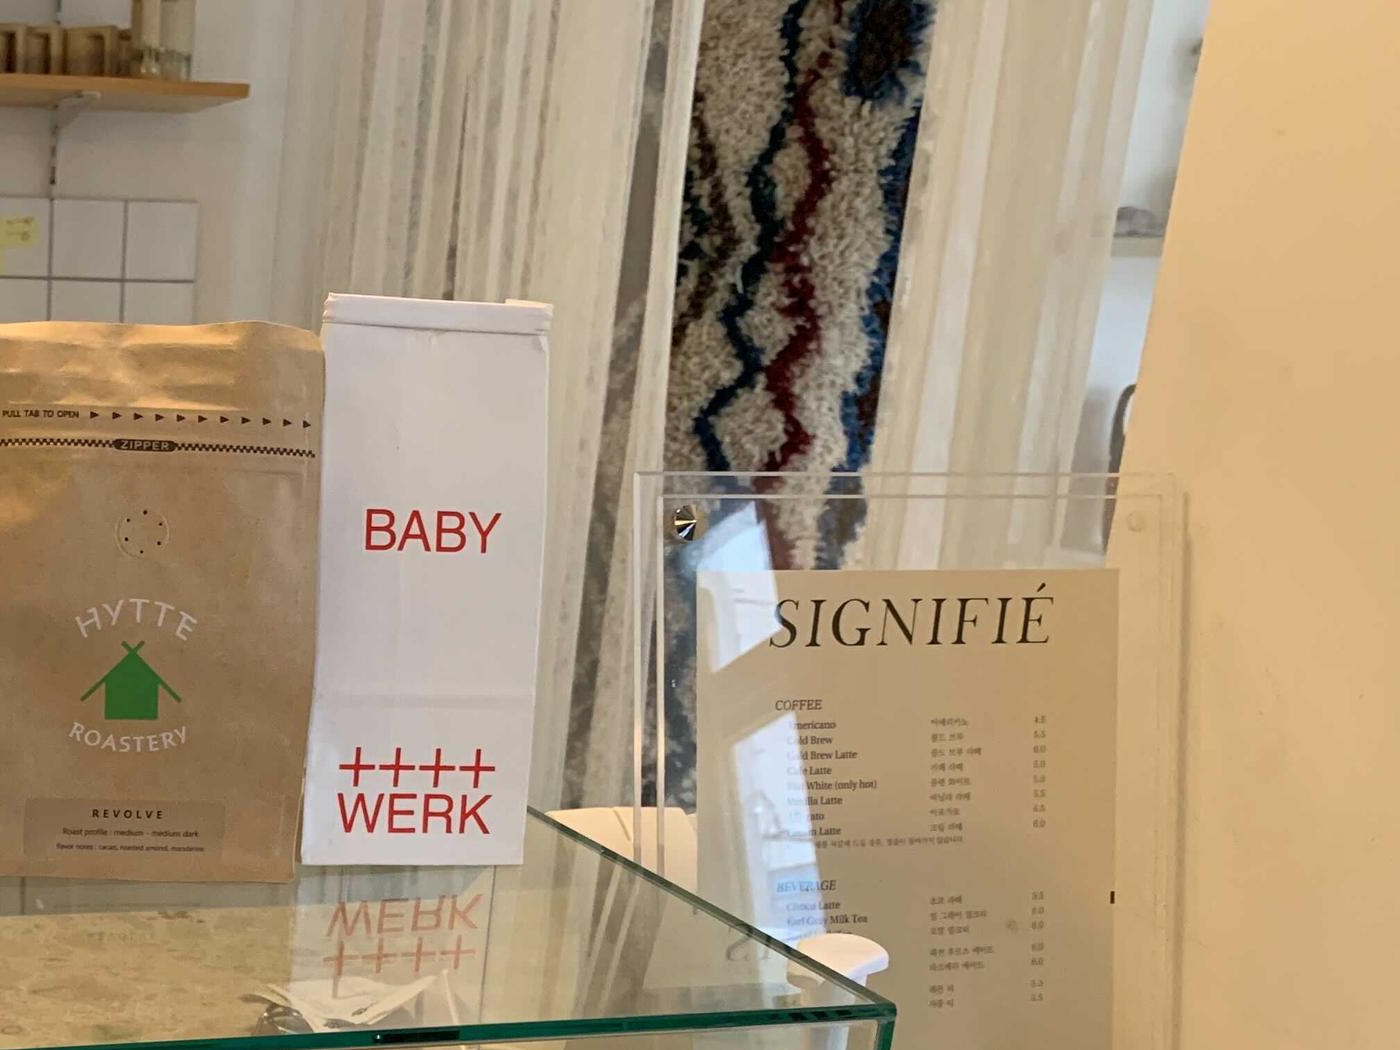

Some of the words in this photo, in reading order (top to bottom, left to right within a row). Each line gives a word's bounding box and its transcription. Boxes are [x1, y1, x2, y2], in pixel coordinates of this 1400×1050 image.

[2, 409, 21, 418] PULL
[24, 409, 40, 418] TAB
[43, 409, 54, 418] TO
[57, 410, 80, 419] OPEN
[119, 439, 170, 451] ZIPPER
[364, 508, 502, 554] BABY
[75, 597, 198, 642] HYTTE
[769, 582, 1054, 649] SIGNIFIÉ
[774, 699, 823, 711] COFFEE
[788, 720, 837, 730] mericano
[68, 721, 187, 752] ROASTERY
[810, 736, 833, 745] Brew
[810, 751, 833, 760] Brew
[835, 750, 858, 759] Latte
[809, 766, 832, 775] Latte
[806, 780, 833, 790] White
[834, 780, 857, 791] (only
[859, 779, 877, 789] hot)
[820, 795, 843, 805] Latte
[92, 809, 164, 819] REVOLVE
[337, 793, 493, 835] WERK
[819, 826, 841, 836] Latte
[829, 915, 850, 924] Milk
[851, 914, 868, 923] Tea
